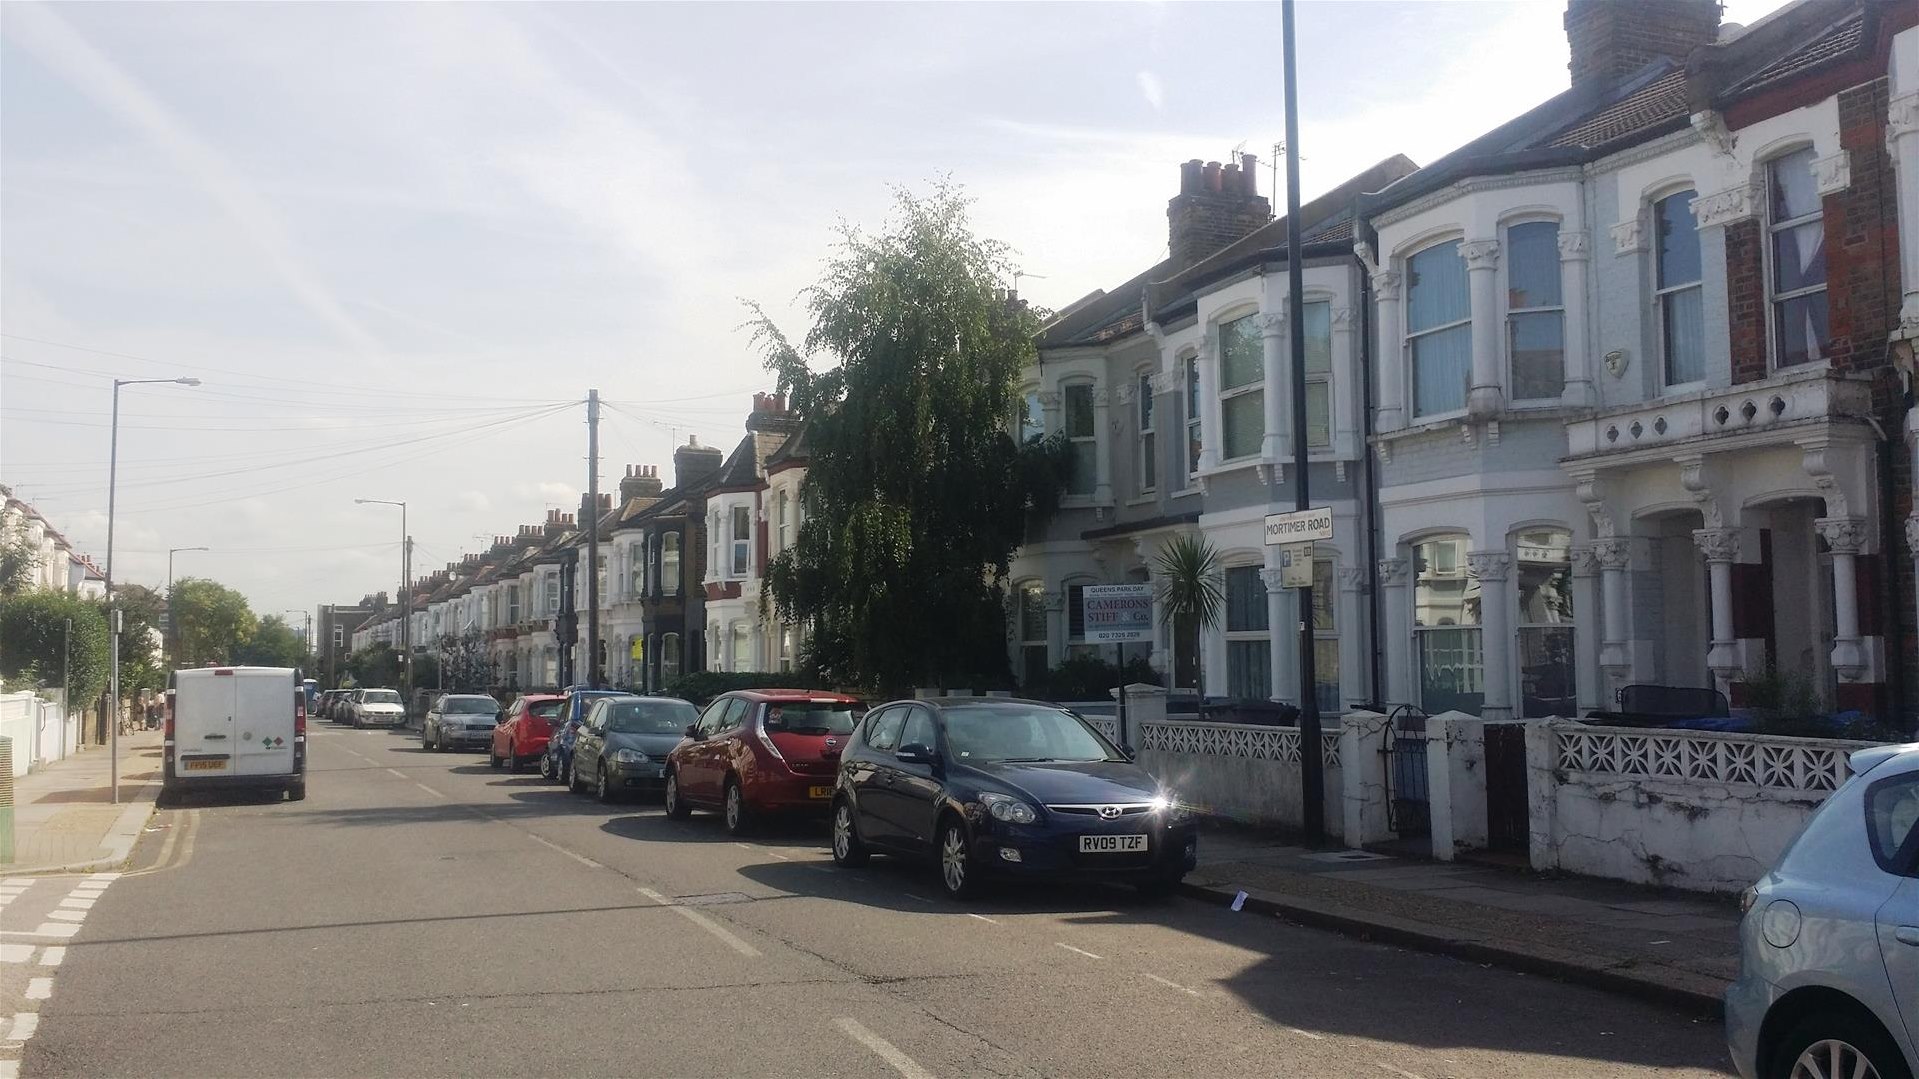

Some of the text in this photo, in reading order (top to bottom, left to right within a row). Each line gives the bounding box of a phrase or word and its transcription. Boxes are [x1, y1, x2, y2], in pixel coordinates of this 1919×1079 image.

[1266, 520, 1306, 535] MORTIMER
[1307, 517, 1330, 530] ROAD
[1087, 599, 1149, 610] CAMERONS
[1088, 611, 1119, 622] STIFF
[1083, 836, 1143, 850] RV09 TZF
